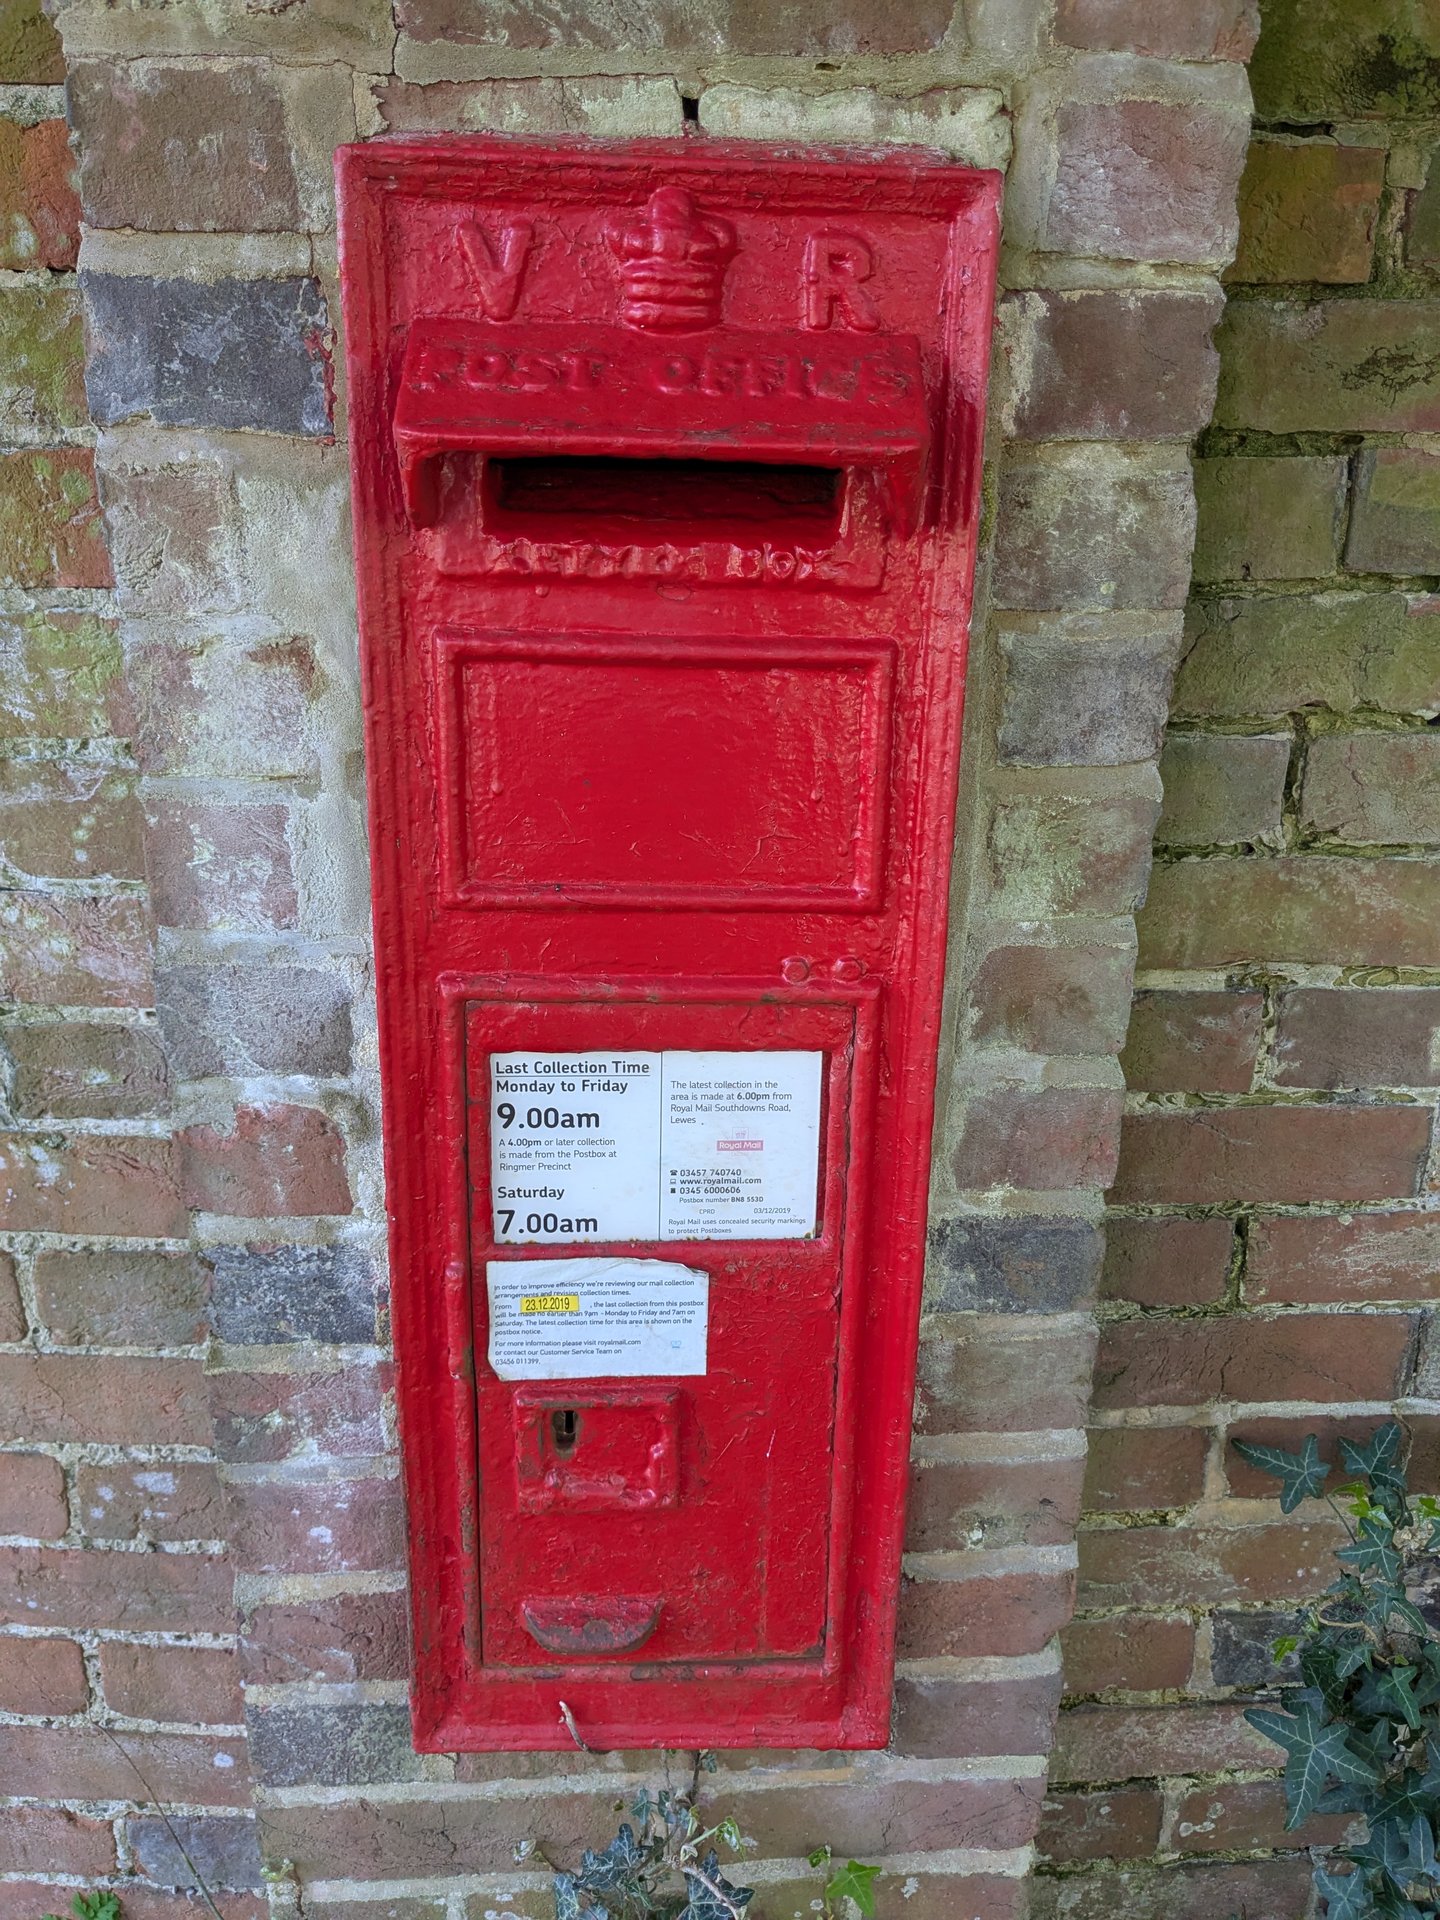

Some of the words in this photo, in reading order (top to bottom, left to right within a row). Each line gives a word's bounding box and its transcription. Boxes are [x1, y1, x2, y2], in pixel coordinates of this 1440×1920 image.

[458, 217, 533, 323] V
[805, 228, 880, 332] R
[408, 345, 600, 392] POST
[496, 1061, 528, 1074] Last
[534, 1061, 606, 1073] Collection
[612, 1061, 649, 1073] Time
[496, 1080, 555, 1094] Monday
[561, 1081, 575, 1092] to
[582, 1079, 628, 1094] Friday
[671, 1081, 686, 1089] The
[690, 1081, 711, 1089] latest
[714, 1081, 751, 1089] collection
[701, 1092, 723, 1100] made
[737, 1092, 769, 1102] 6.00pm
[773, 1092, 792, 1100] from
[671, 1104, 692, 1113] Royal
[769, 1104, 791, 1112] Road,
[497, 1103, 599, 1129] 9.00am
[671, 1116, 696, 1124] Lewes
[508, 1139, 541, 1148] 4.00pm
[556, 1138, 574, 1146] later
[577, 1138, 615, 1146] collection
[500, 1163, 534, 1172] Ringmer
[680, 1177, 761, 1185] www.royalmail.com
[497, 1186, 564, 1200] Saturday
[497, 1210, 598, 1234] 7.00am
[525, 1297, 570, 1311] 23.12.2019
